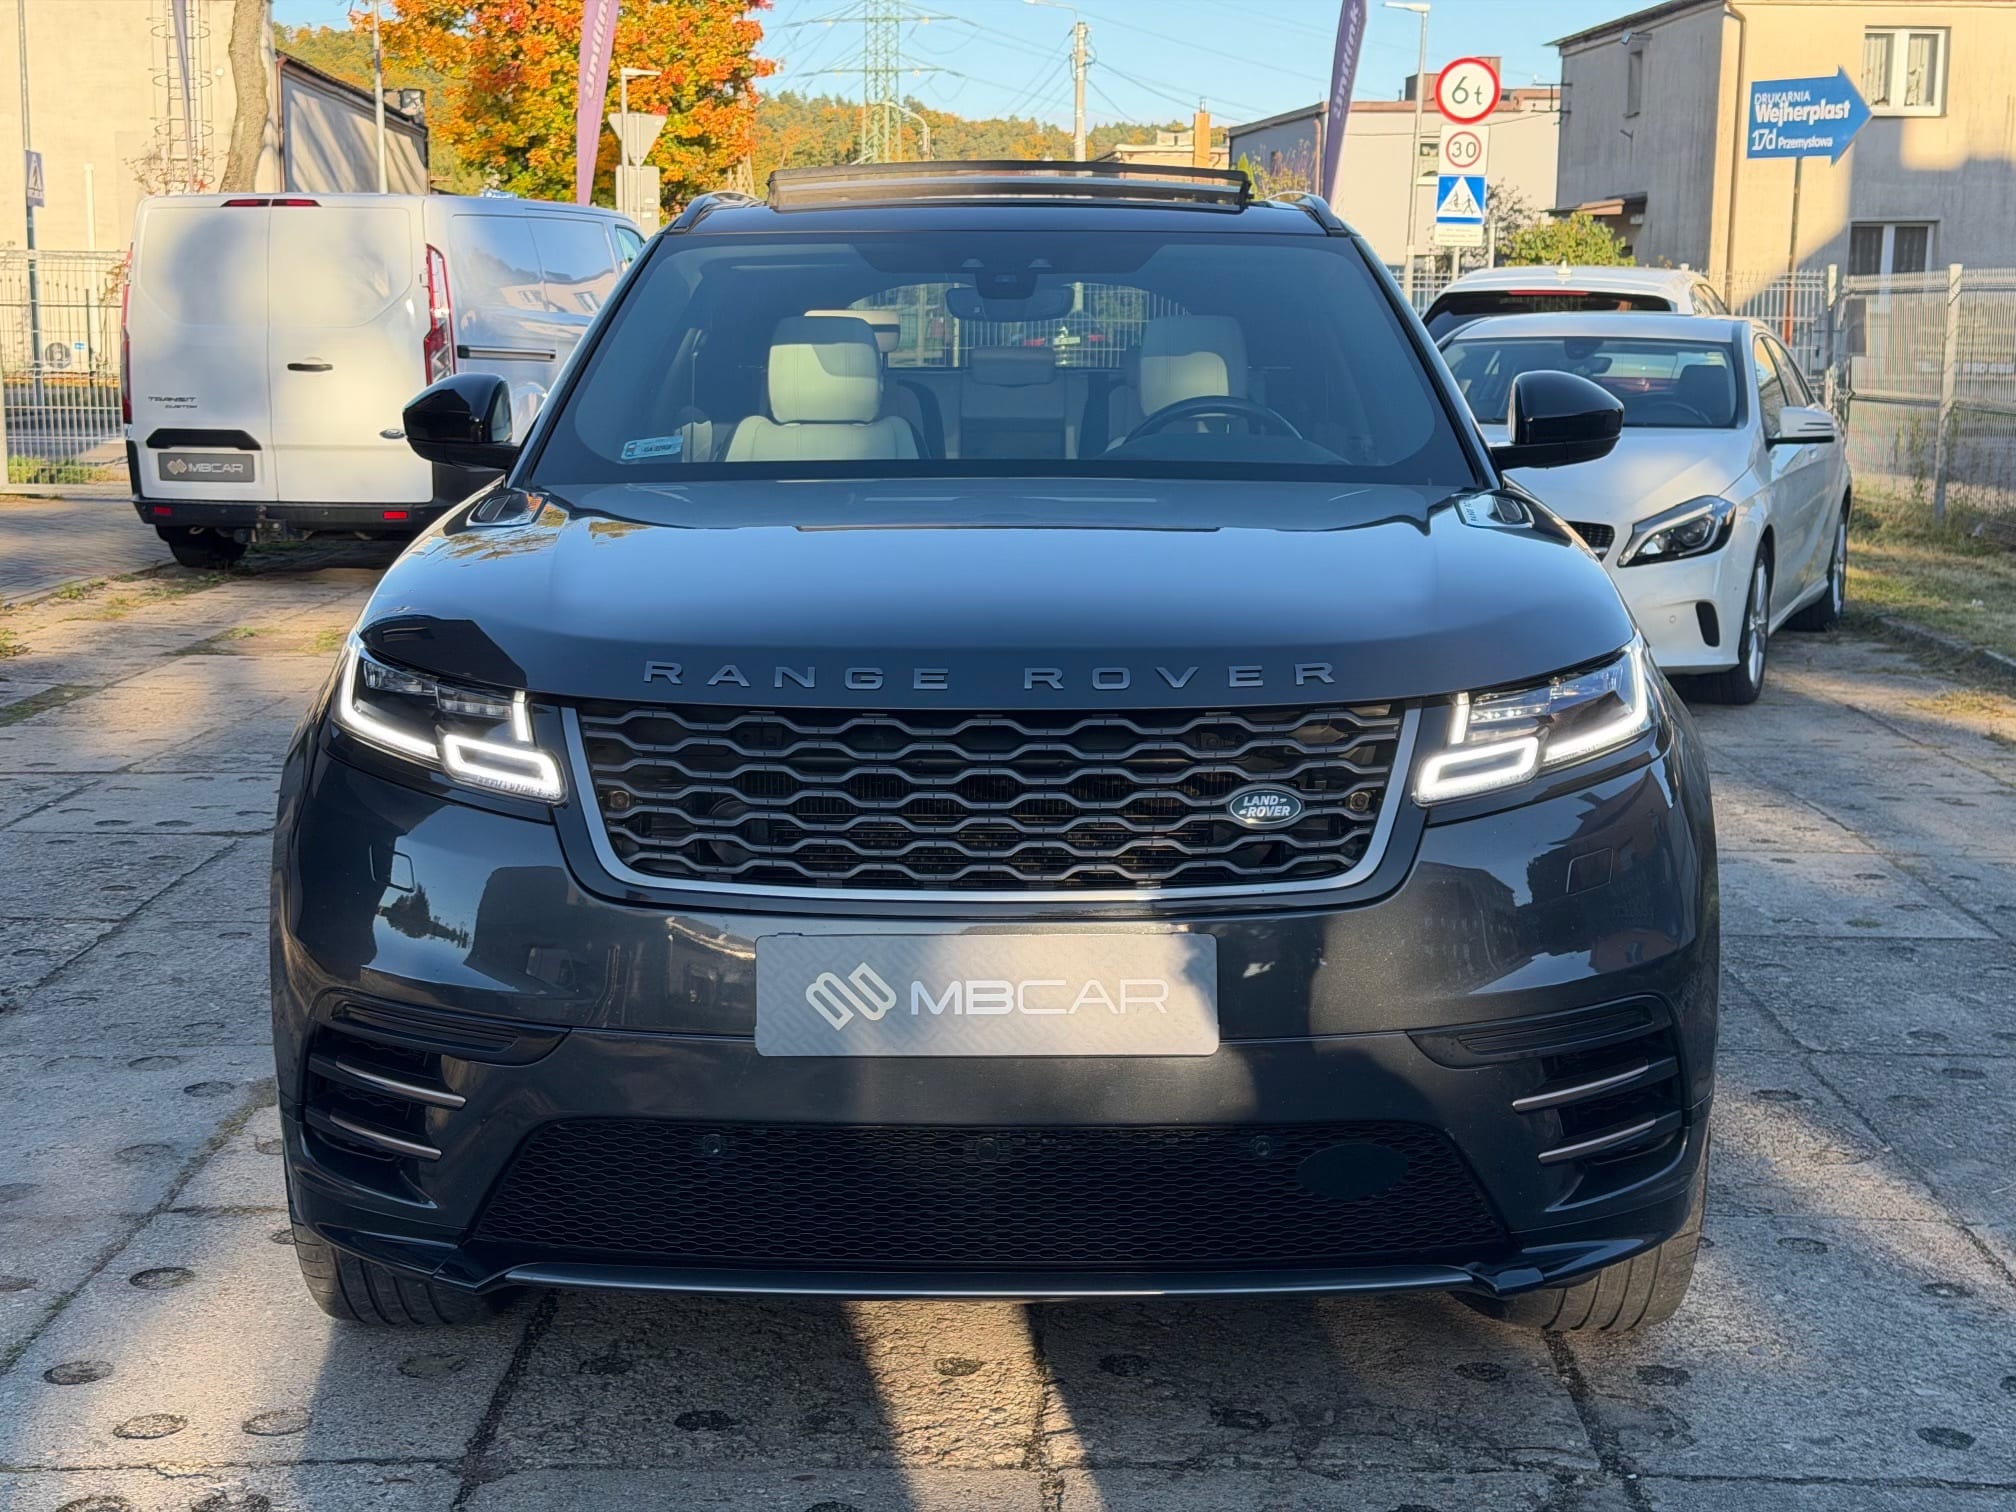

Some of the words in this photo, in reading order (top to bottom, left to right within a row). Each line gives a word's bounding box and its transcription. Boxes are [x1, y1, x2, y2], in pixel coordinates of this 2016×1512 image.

[585, 0, 608, 98] Unilin
[1451, 76, 1469, 104] 6
[1474, 85, 1482, 105] t
[1754, 90, 1811, 105] DRUKARNIA
[1755, 98, 1850, 126] Wejherplast
[1451, 141, 1477, 158] 30
[1752, 128, 1777, 151] 17d
[188, 463, 243, 473] MBCAR
[643, 661, 949, 690] RANGE
[1024, 662, 1336, 690] ROVER
[1246, 805, 1291, 818] ROVER
[910, 979, 1168, 1016] MBCAR
